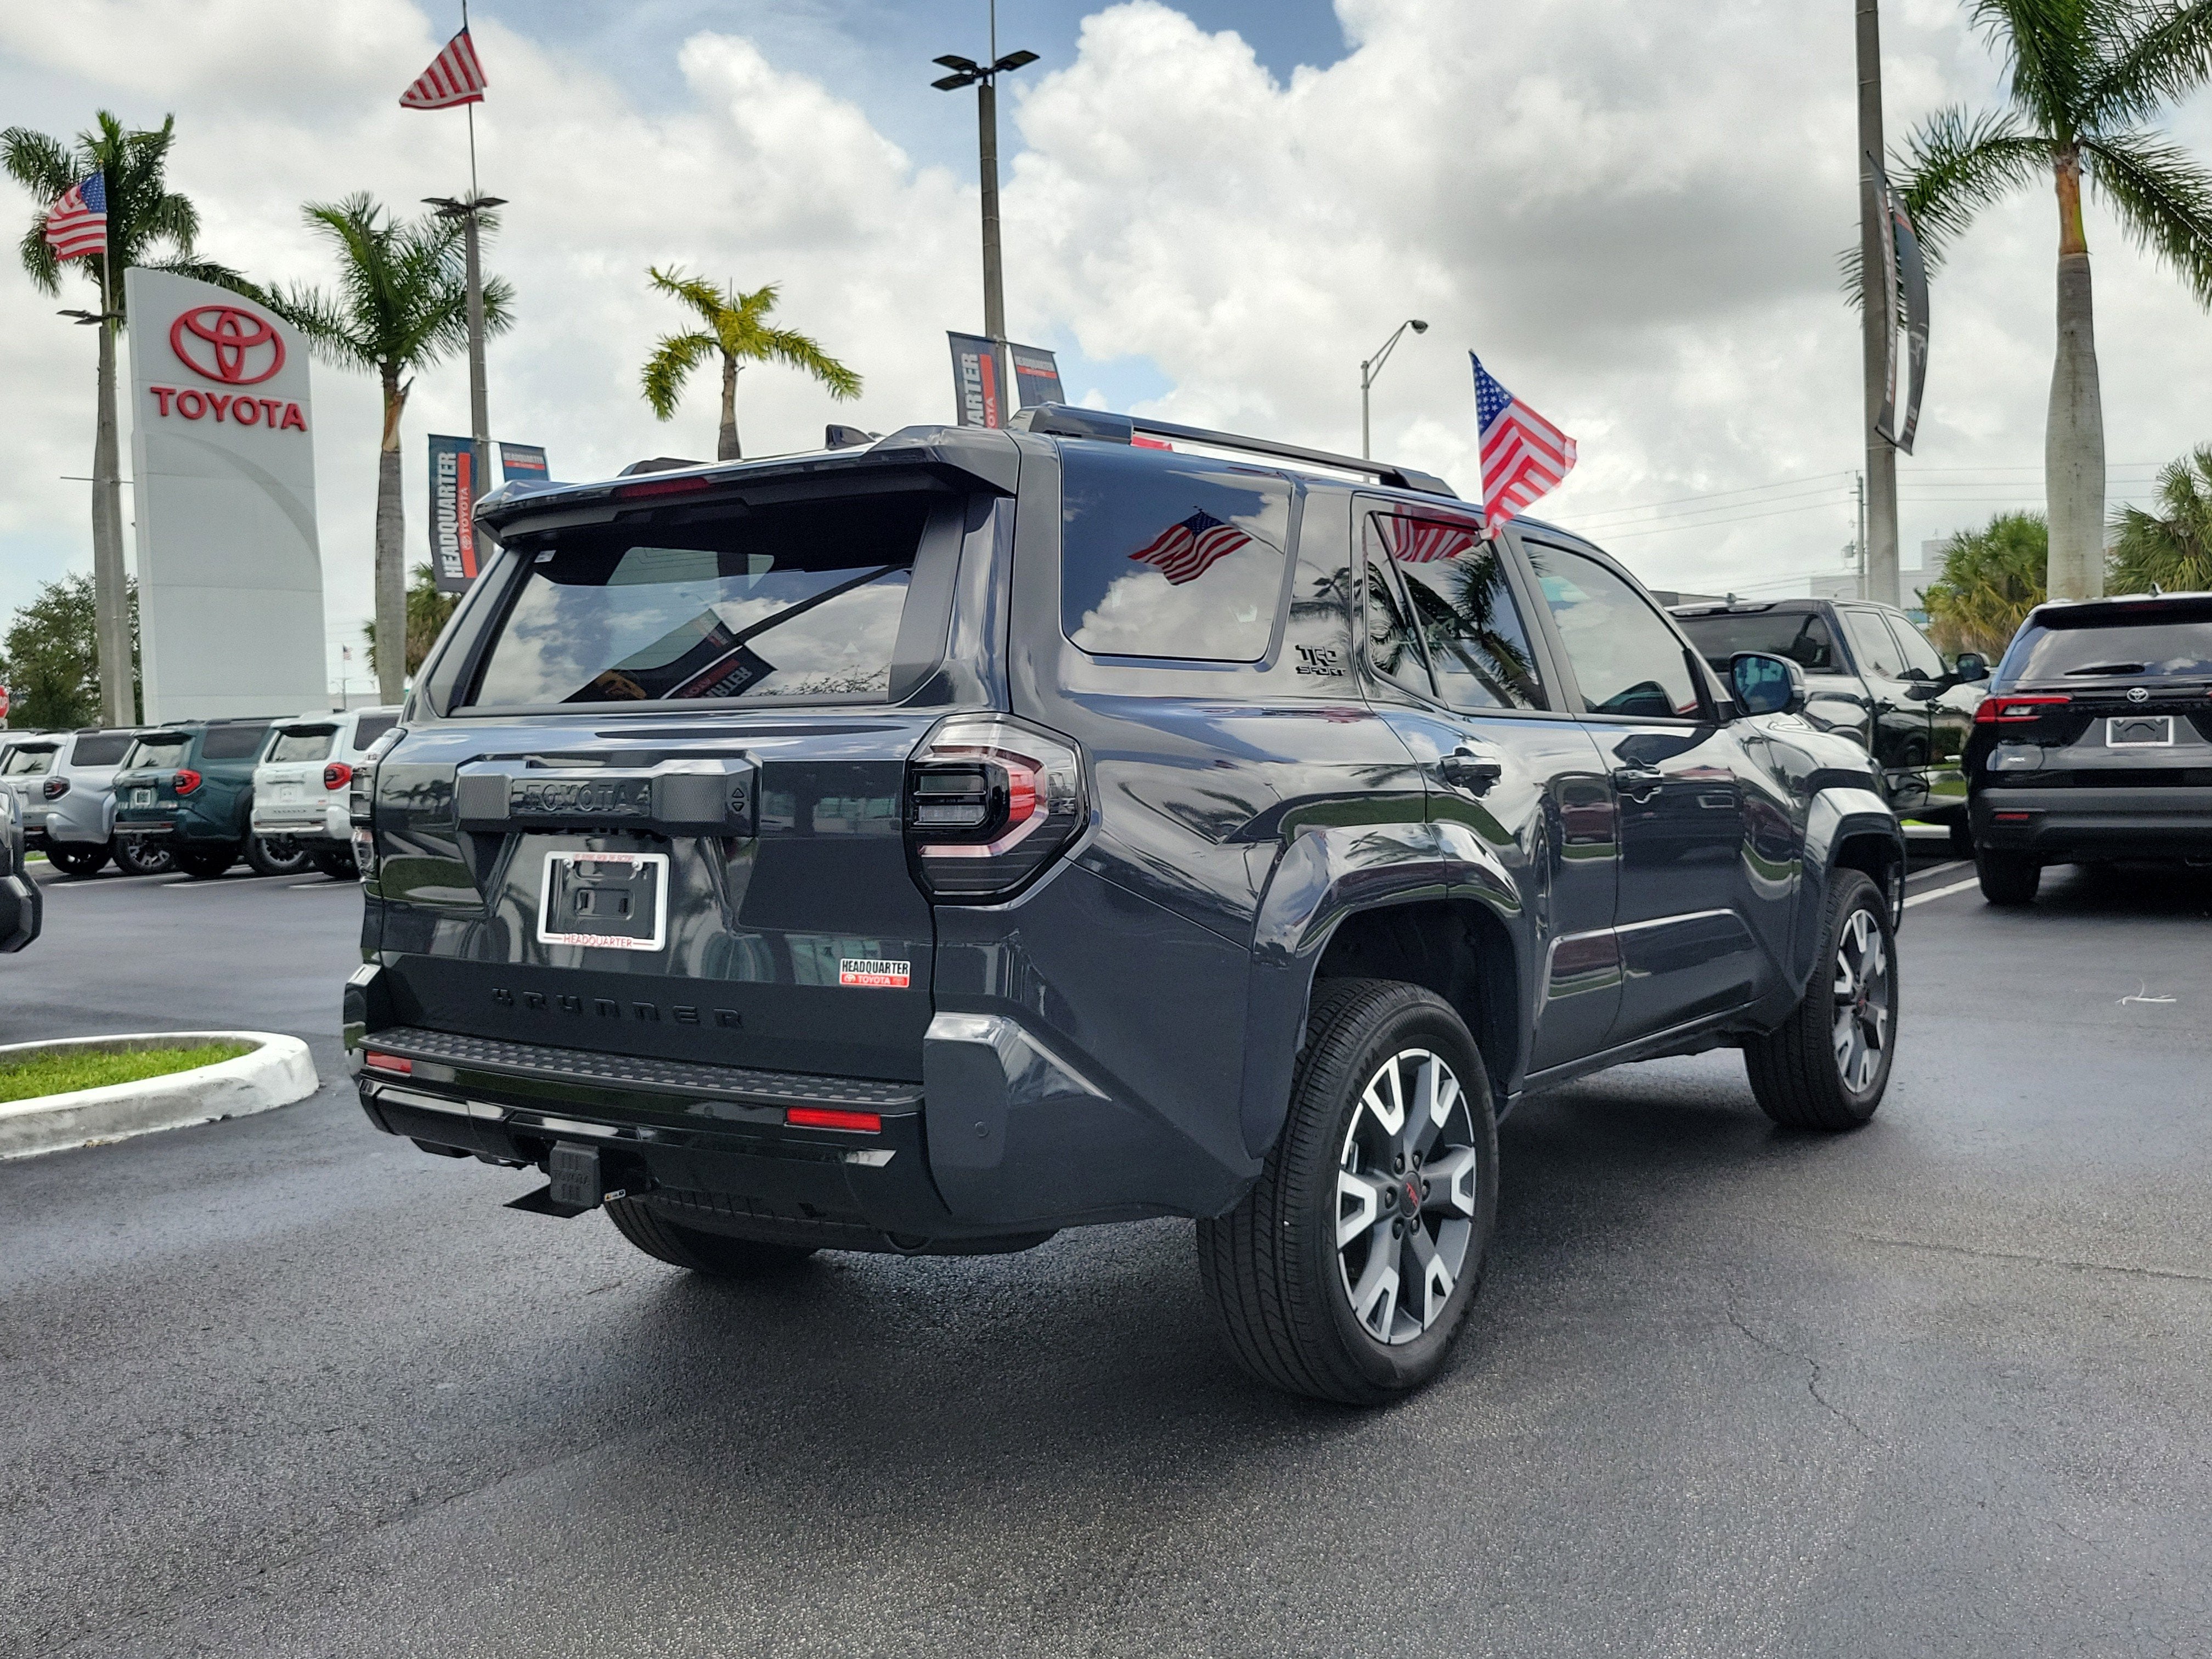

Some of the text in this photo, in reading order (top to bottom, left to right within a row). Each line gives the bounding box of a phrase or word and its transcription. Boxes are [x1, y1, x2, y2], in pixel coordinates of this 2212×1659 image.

[150, 386, 307, 432] TOYOTA
[438, 452, 464, 578] HEADQUARTER
[460, 487, 470, 533] TOYOTA
[1295, 644, 1340, 666] TRD
[1295, 665, 1346, 676] SPORT
[526, 783, 635, 812] TOYOTA
[563, 934, 633, 947] HEADQUARTER
[842, 960, 909, 975] HEADQUARTER
[858, 975, 891, 985] TOYOTA
[492, 987, 743, 1029] 4RUNNER
